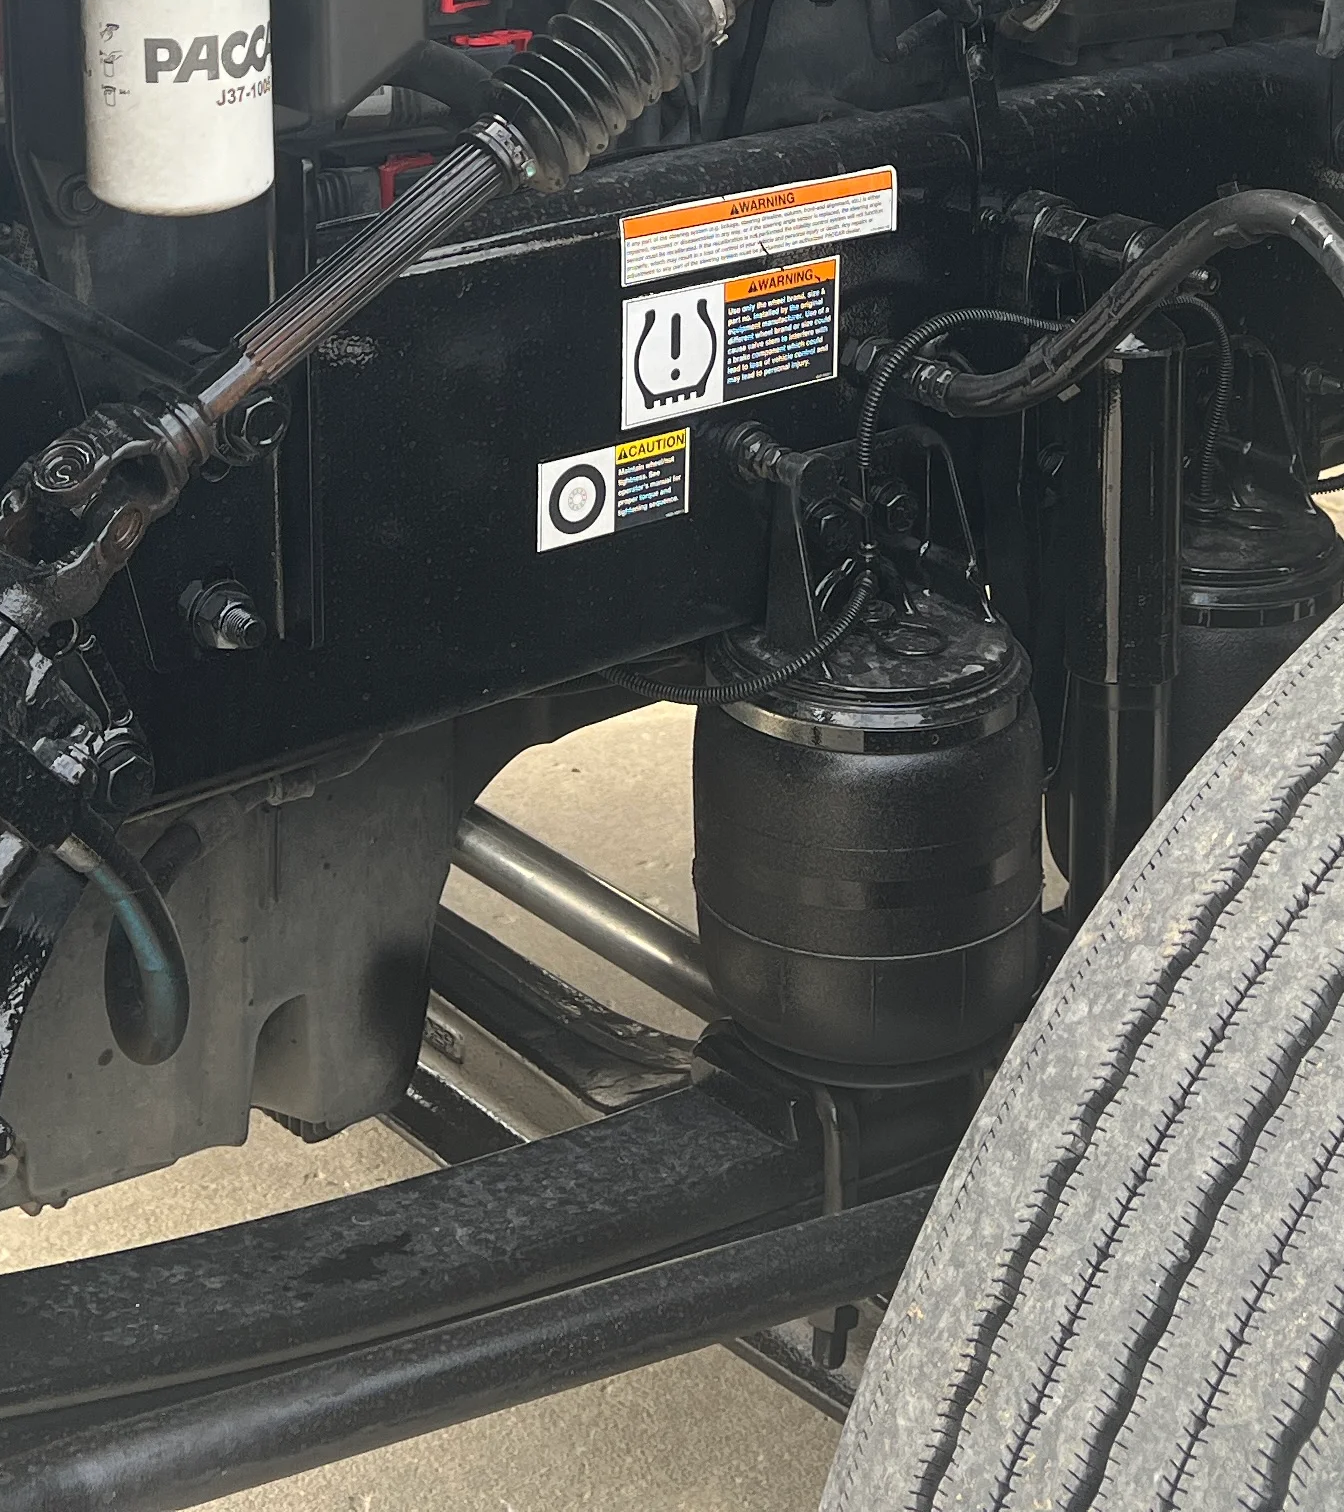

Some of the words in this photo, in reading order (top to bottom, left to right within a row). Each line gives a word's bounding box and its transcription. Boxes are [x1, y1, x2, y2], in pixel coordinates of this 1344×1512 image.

[737, 192, 796, 214] WARNING
[757, 269, 814, 291] WARNING
[629, 433, 684, 457] CAUTION
